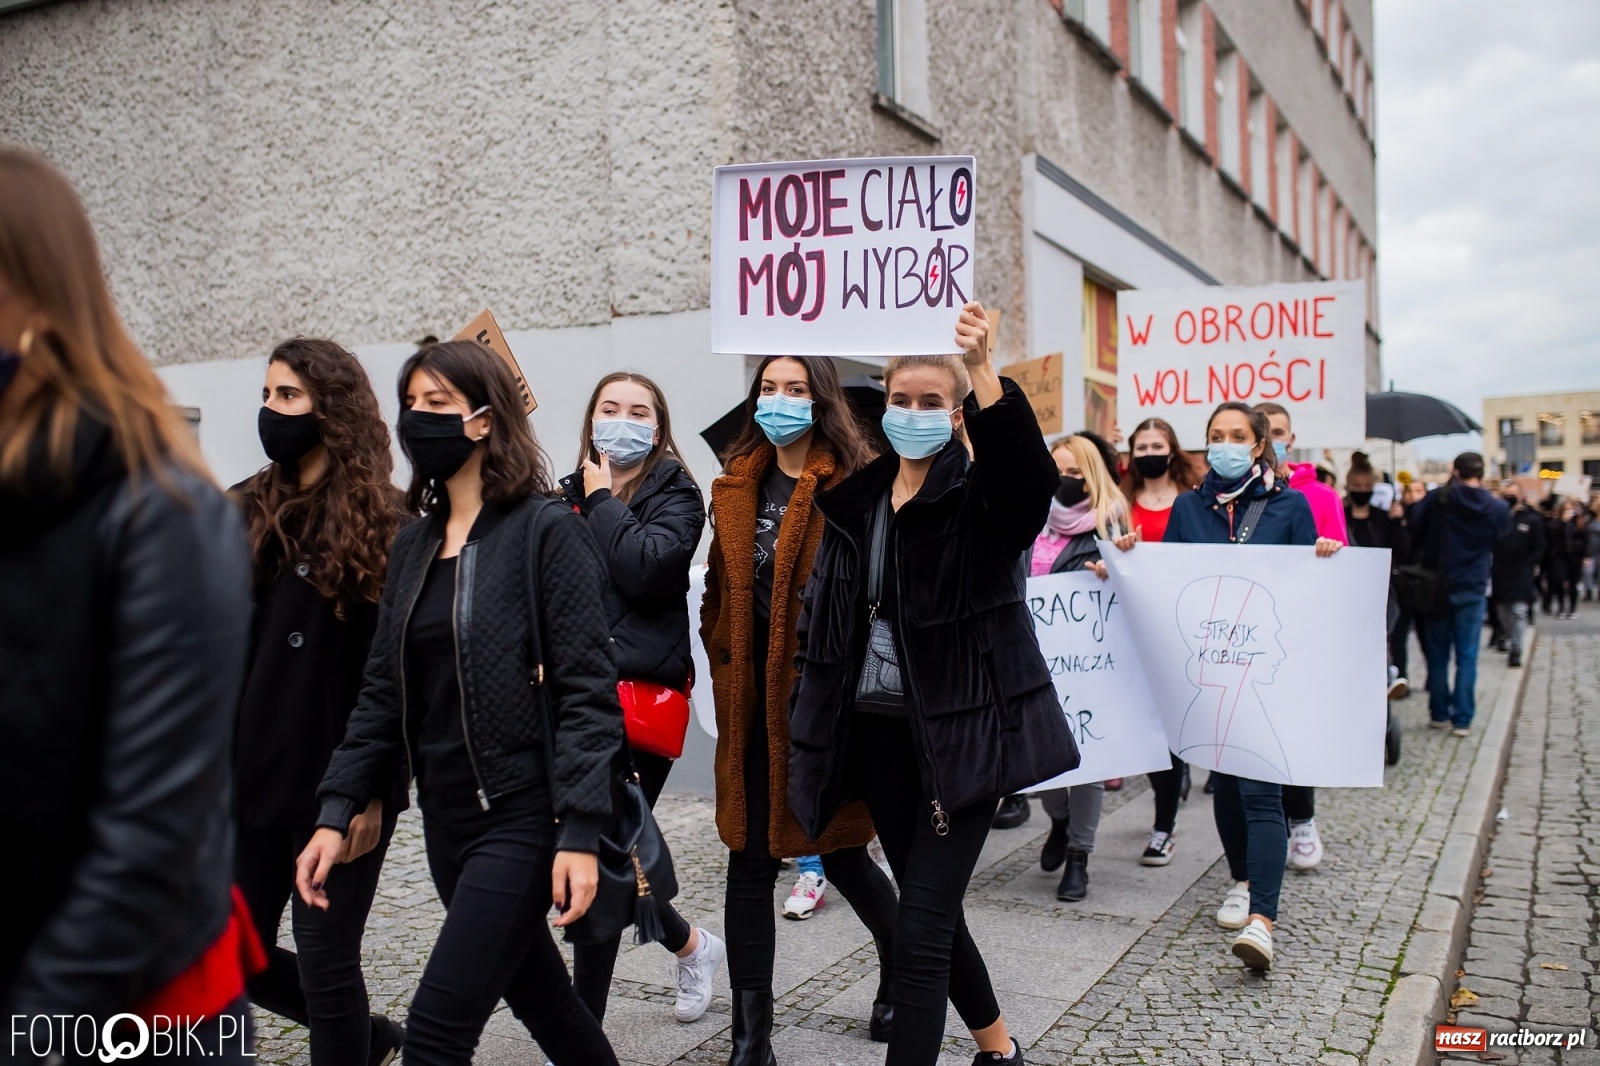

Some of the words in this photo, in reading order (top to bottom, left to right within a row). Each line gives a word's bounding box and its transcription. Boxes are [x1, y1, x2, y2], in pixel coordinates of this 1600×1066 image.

[738, 169, 853, 242] MOJE
[860, 165, 973, 232] CIAŁO
[738, 242, 827, 322] MÓJ
[841, 238, 969, 309] WYBÓR
[1126, 314, 1153, 346] W
[1175, 297, 1336, 345] OBRONIE
[1133, 350, 1326, 407] WOLNOŚCI
[1027, 590, 1119, 643] RACJA
[1194, 619, 1259, 648] STRAJK
[1046, 652, 1116, 676] ZNACZA
[1197, 648, 1267, 667] KOBIET
